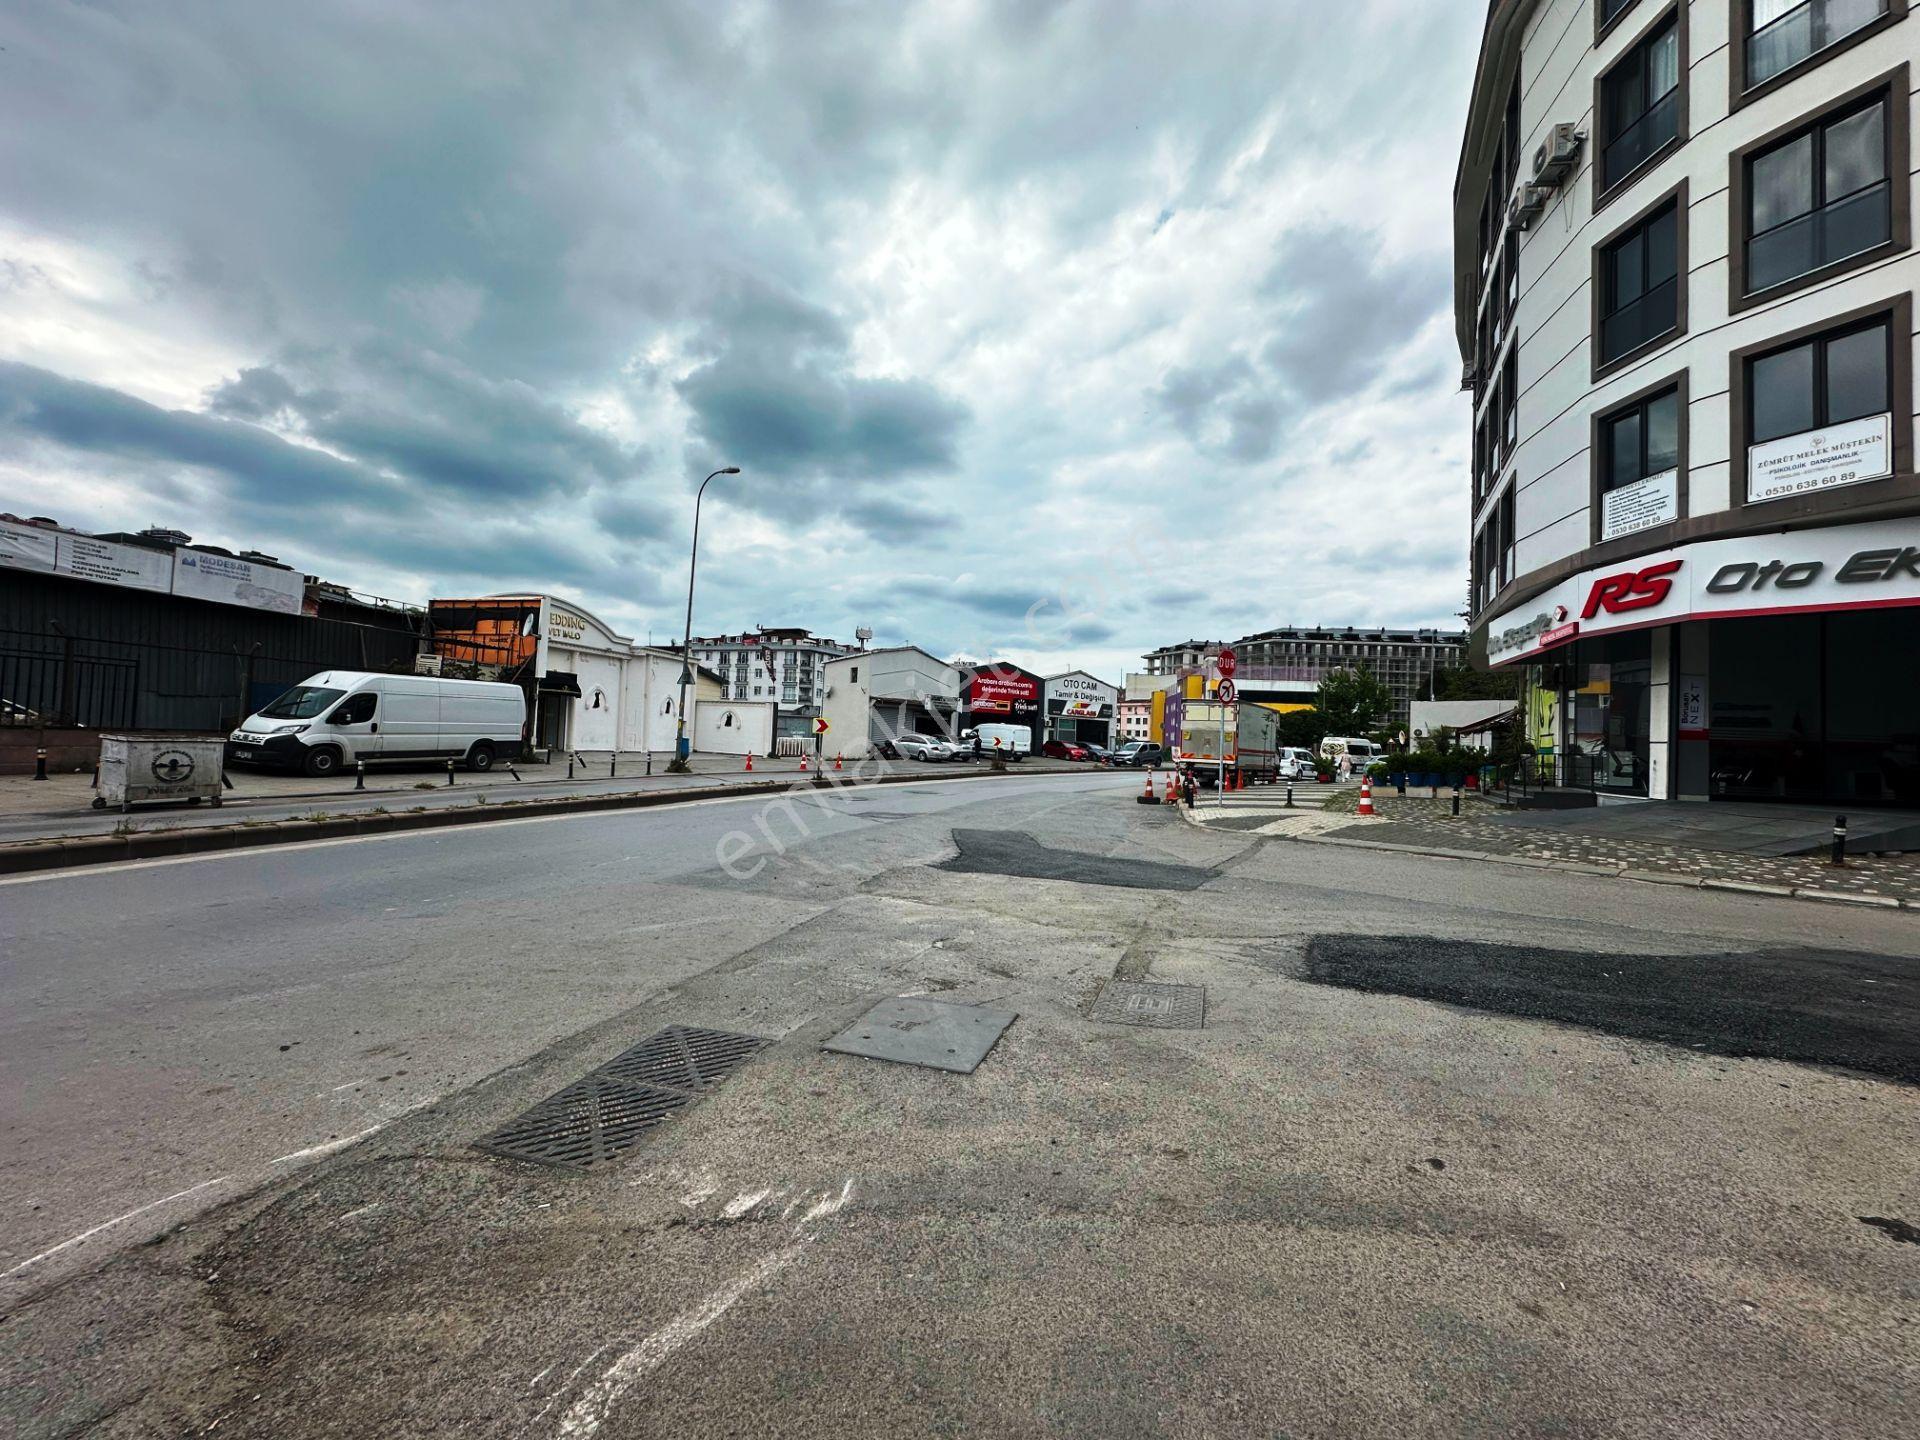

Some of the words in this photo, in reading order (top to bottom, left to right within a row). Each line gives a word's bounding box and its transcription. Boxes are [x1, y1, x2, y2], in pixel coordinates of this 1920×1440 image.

[1757, 454, 1794, 469] ZÜMRÜT
[1797, 447, 1829, 461] MELEK
[1765, 484, 1793, 496] 0530
[1796, 479, 1818, 490] 638
[1821, 475, 1836, 485] 60
[1840, 471, 1855, 481] 89
[199, 556, 251, 573] MODESAN
[1705, 559, 1824, 594] Oto
[1579, 559, 1685, 619] RS
[549, 612, 586, 630] EDDING
[1219, 657, 1235, 668] DUR
[1055, 690, 1073, 698] Tamir
[1063, 679, 1080, 689] OTO
[1081, 681, 1097, 690] CAM
[1689, 682, 1700, 724] NEXT
